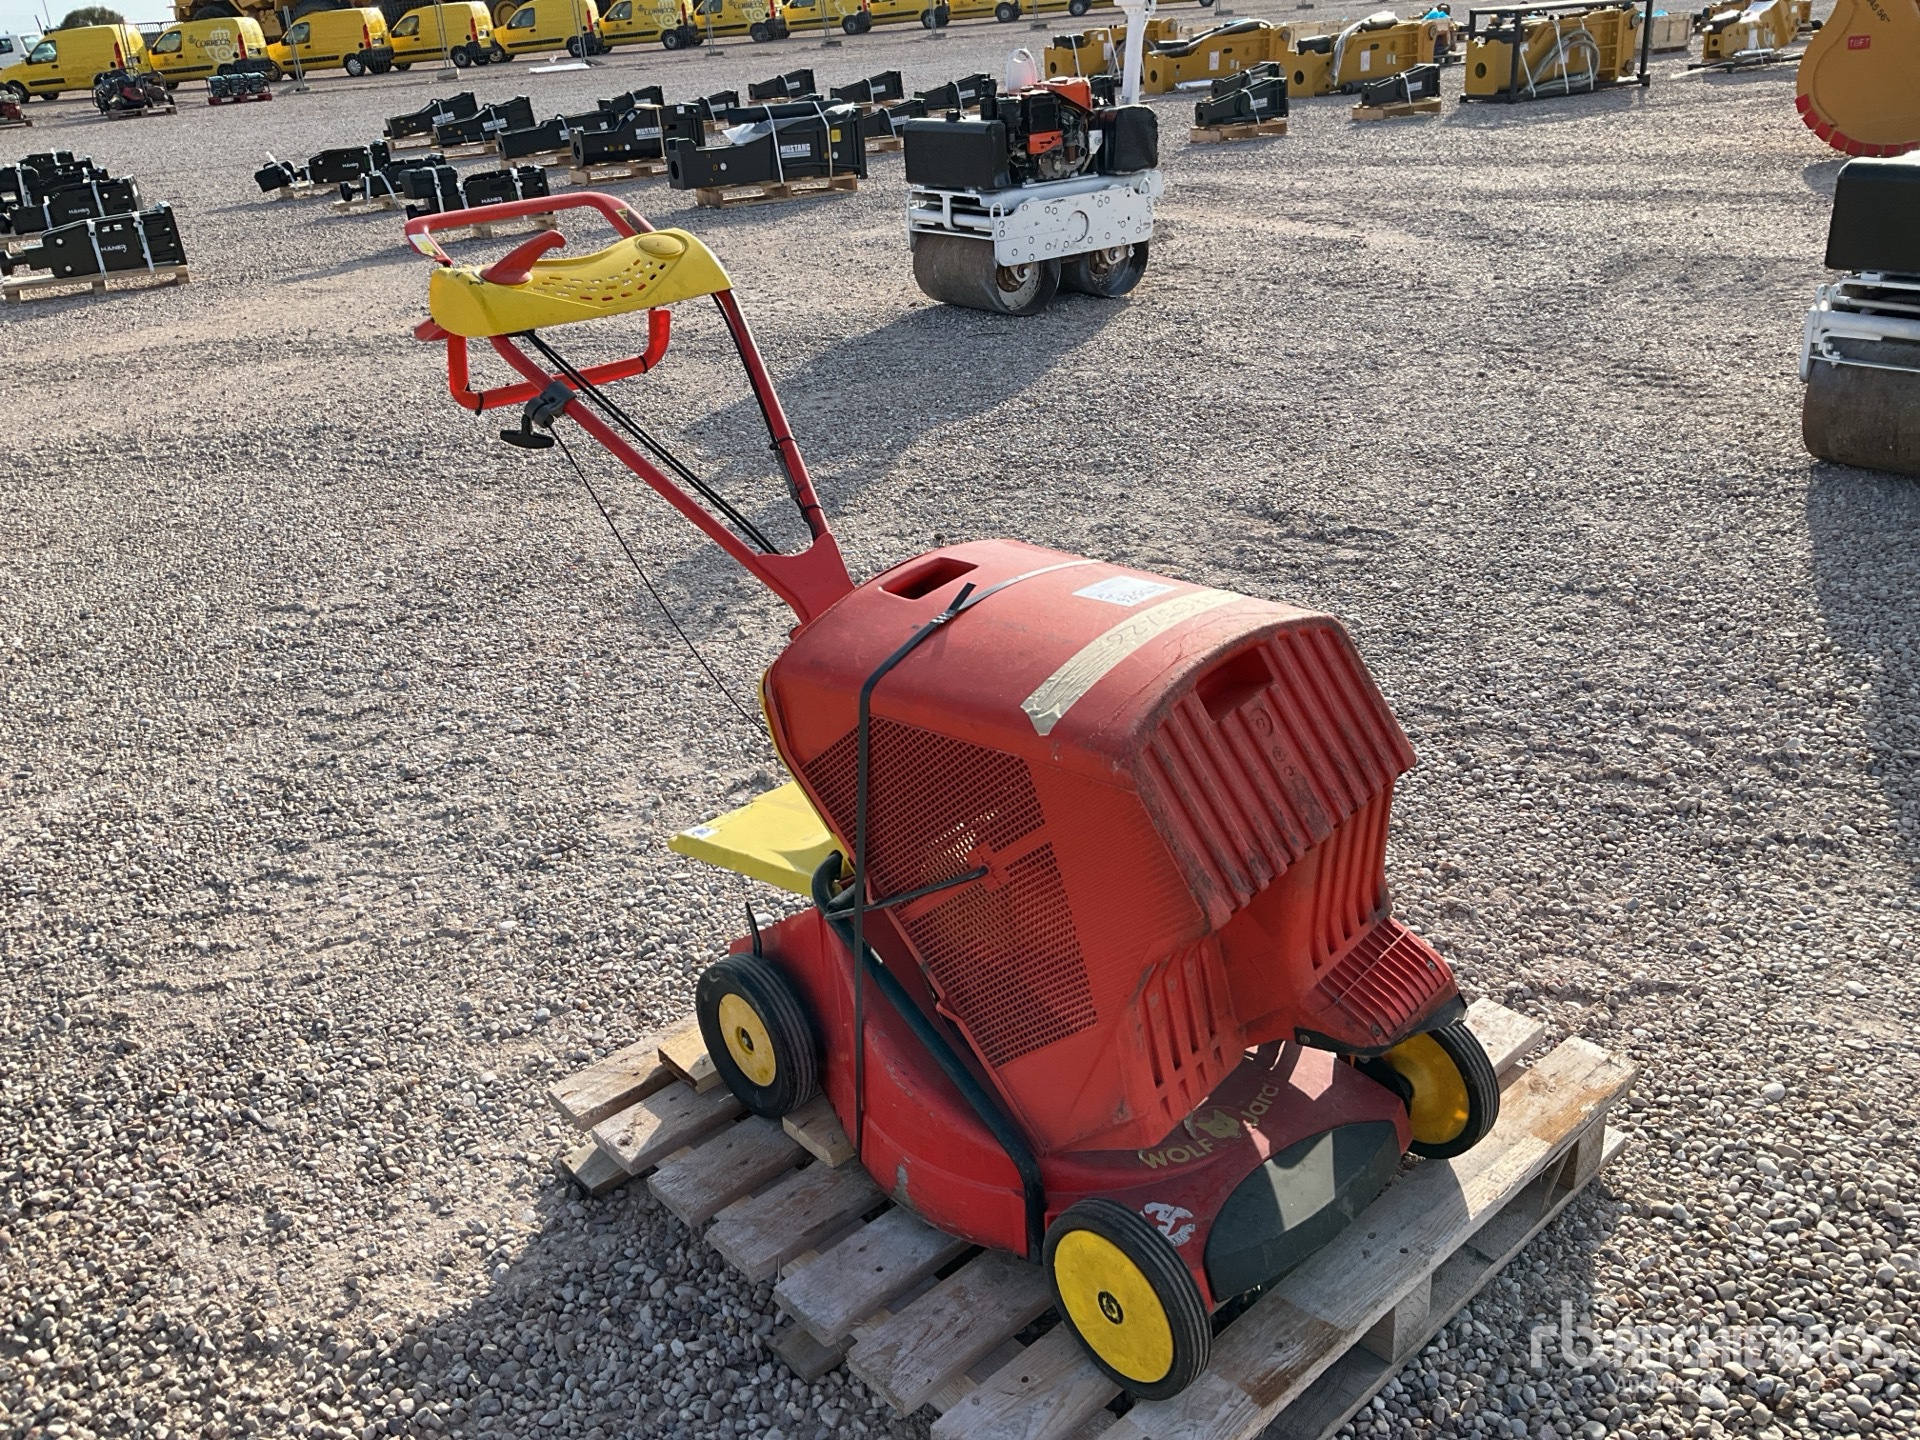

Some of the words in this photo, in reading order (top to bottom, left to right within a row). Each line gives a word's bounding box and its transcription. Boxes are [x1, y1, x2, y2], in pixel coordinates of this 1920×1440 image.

[195, 37, 231, 48] CORREOS
[780, 143, 810, 153] MUSTANG
[1139, 1138, 1214, 1169] WOLF
